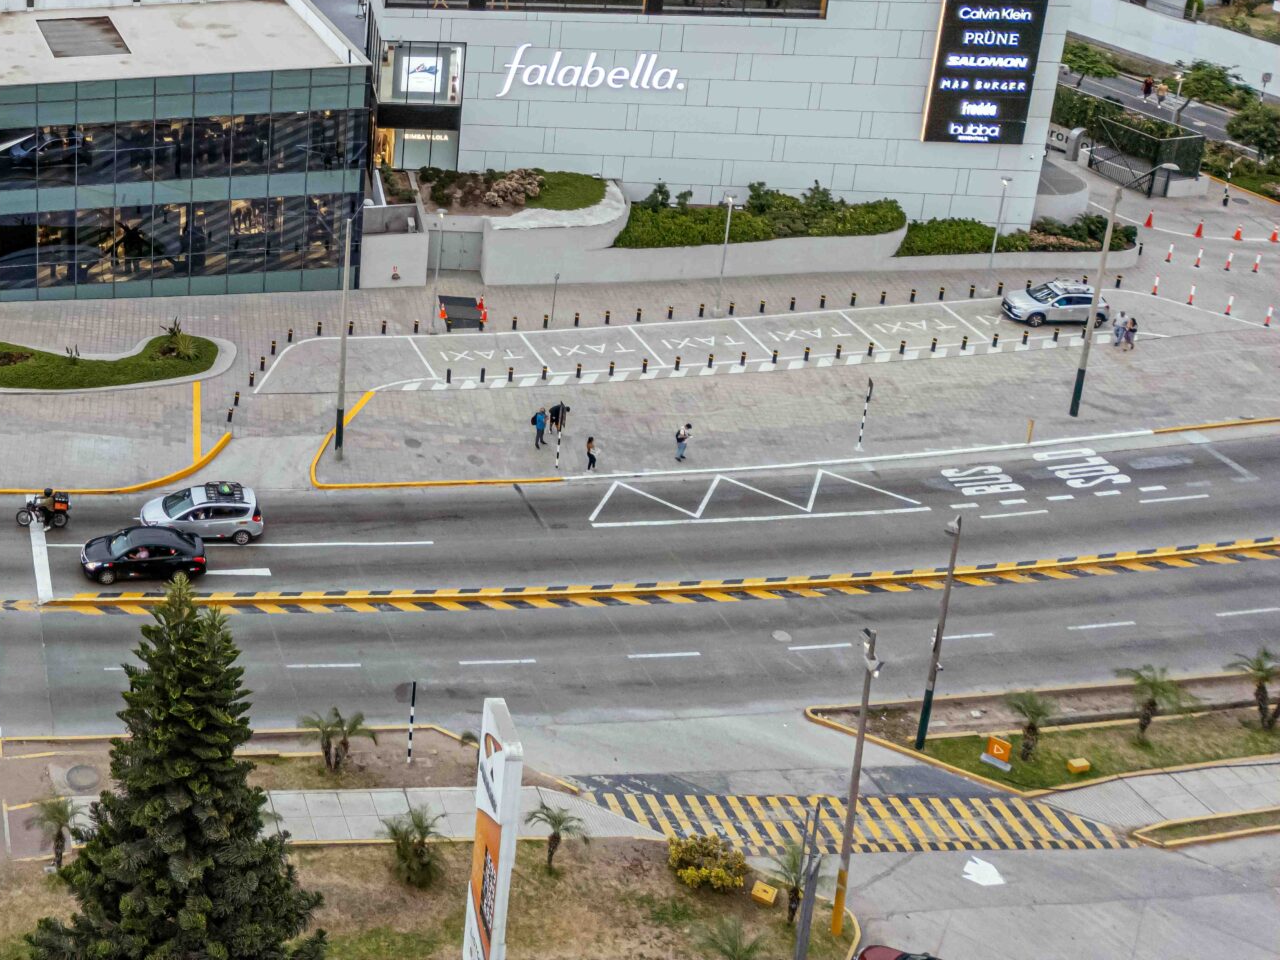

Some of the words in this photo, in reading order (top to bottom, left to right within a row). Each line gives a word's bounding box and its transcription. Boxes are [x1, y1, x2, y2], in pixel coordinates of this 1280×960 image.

[959, 7, 999, 19] Calvin
[1001, 8, 1032, 20] Klein
[963, 30, 1020, 45] PRÜNE
[946, 56, 1028, 68] SALOMON
[940, 80, 969, 89] MAD
[974, 80, 1026, 91] BURGER
[950, 123, 999, 137] bubba
[873, 319, 957, 333] TAXI
[768, 327, 852, 341] TAXI
[551, 342, 636, 356] TAXI
[661, 335, 745, 349] TAXI
[440, 349, 524, 361] TAXI
[1032, 448, 1132, 488] SOLO
[941, 465, 1025, 496] BUS
